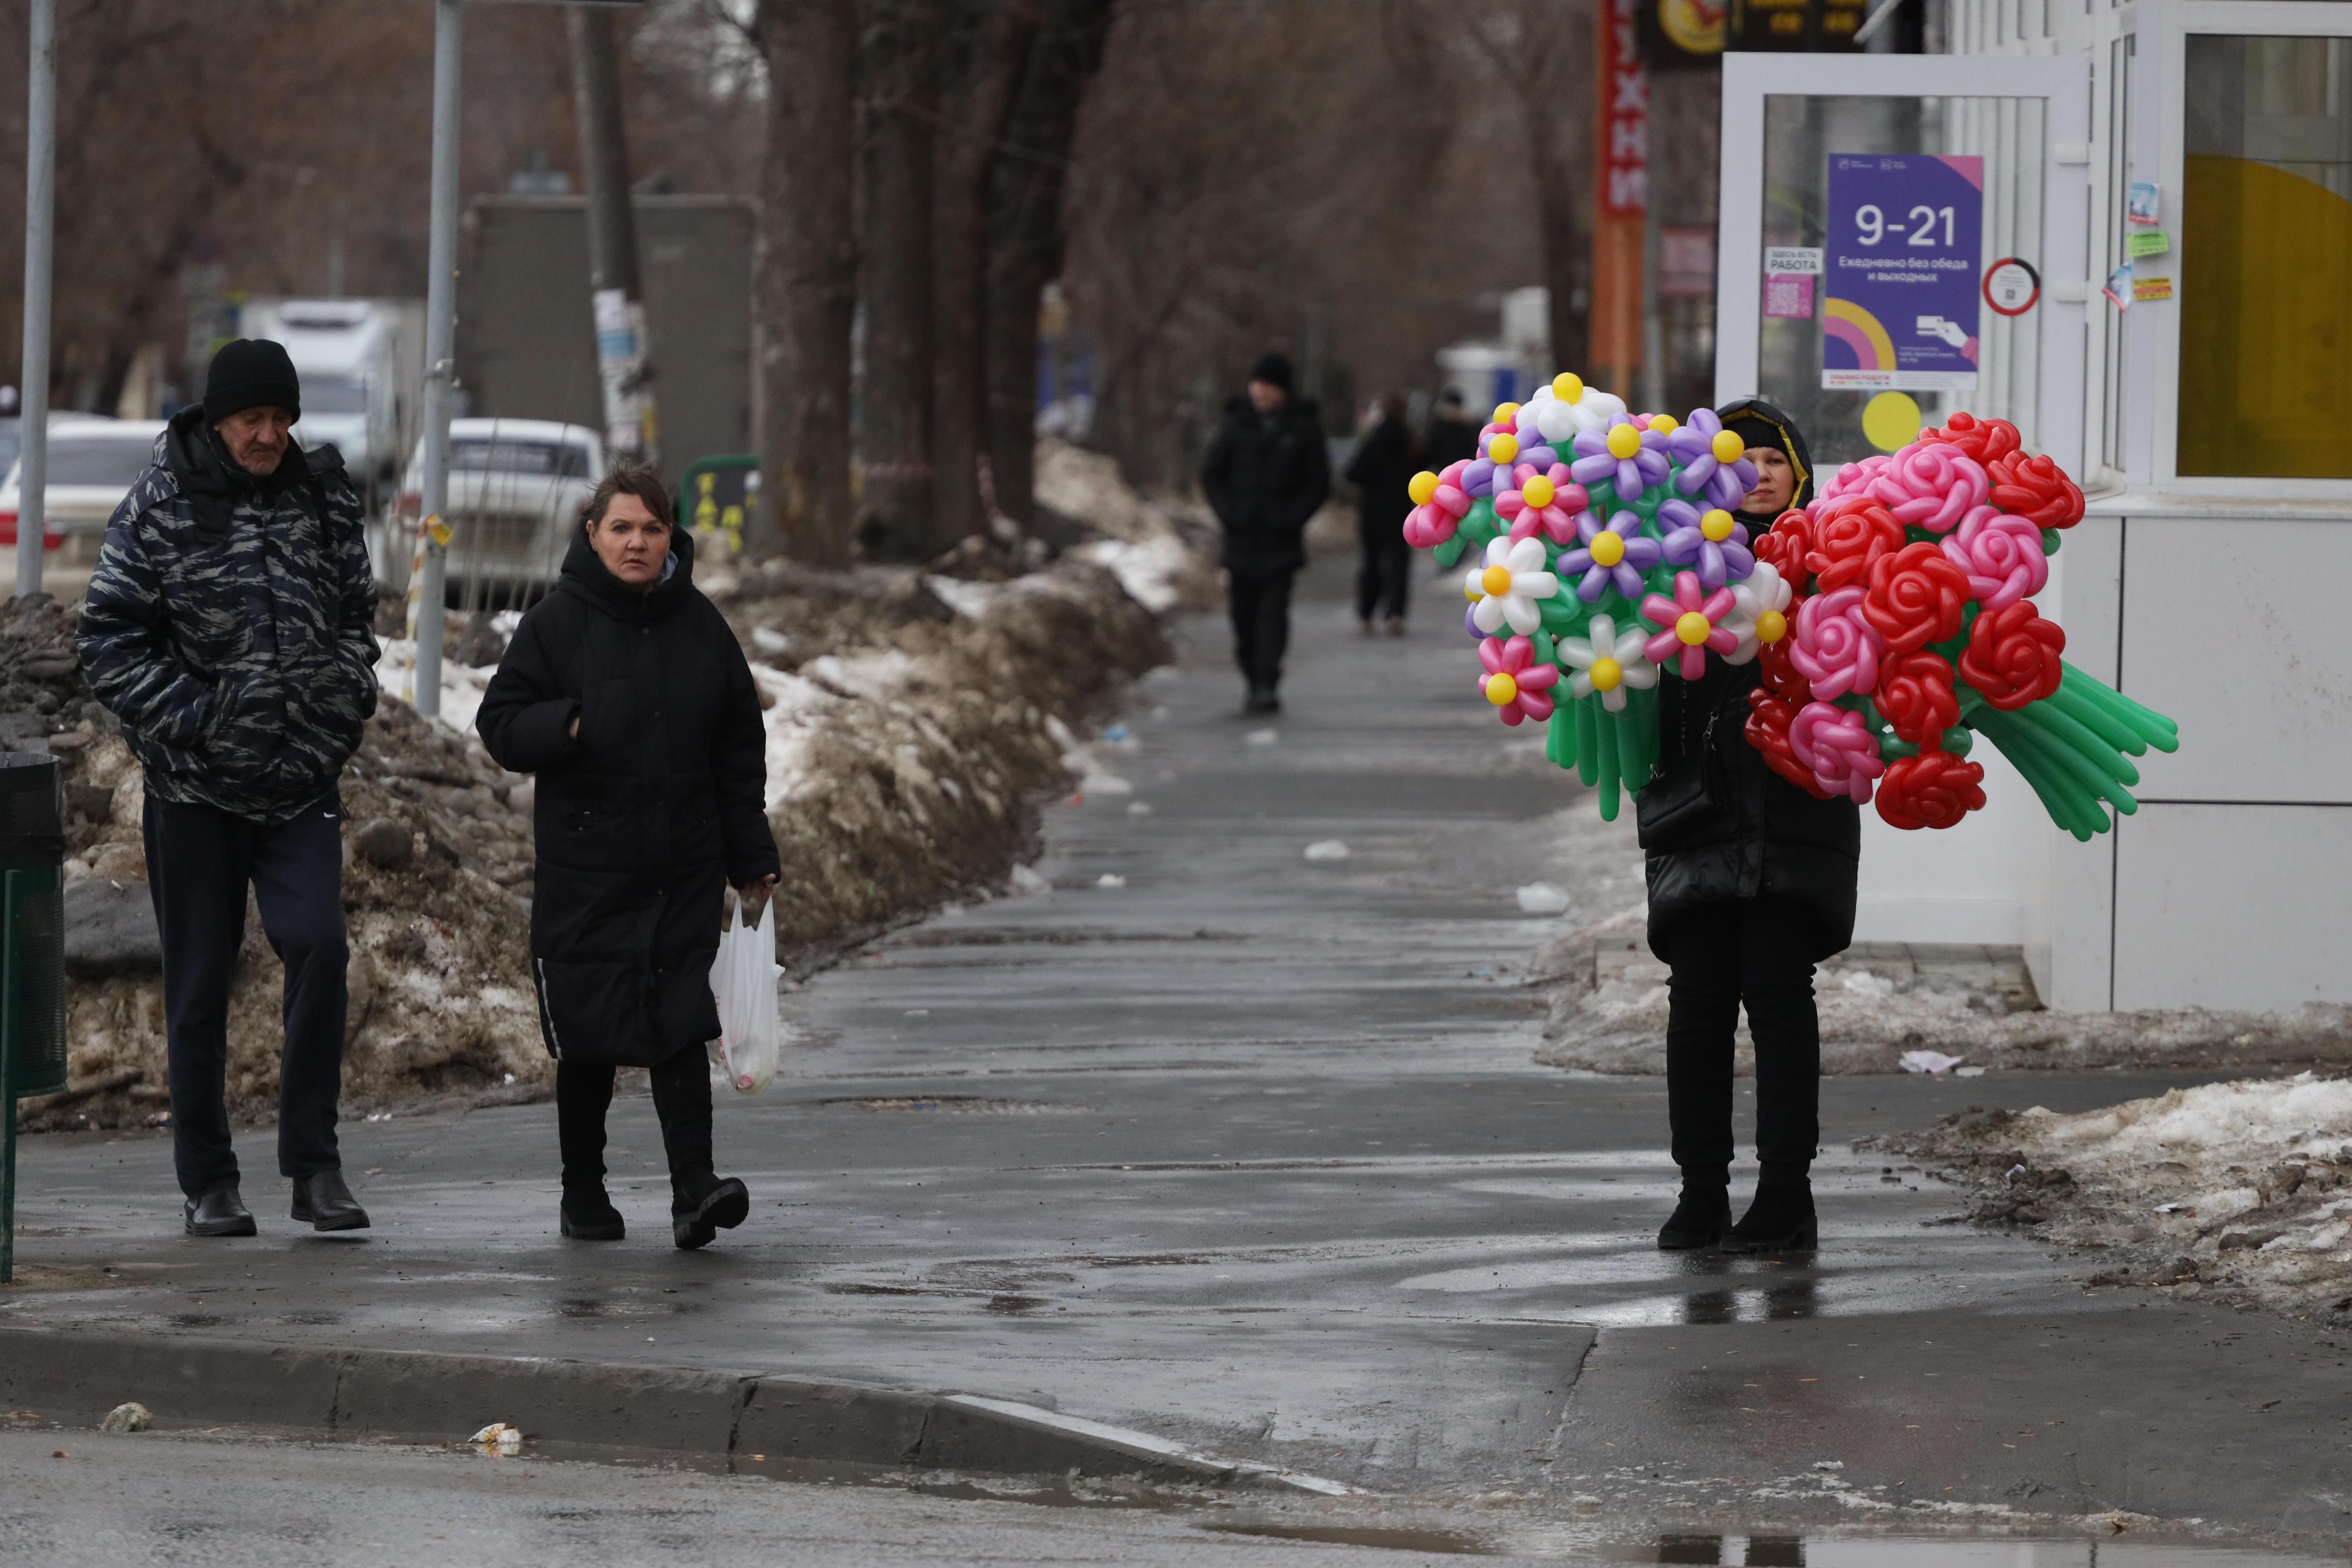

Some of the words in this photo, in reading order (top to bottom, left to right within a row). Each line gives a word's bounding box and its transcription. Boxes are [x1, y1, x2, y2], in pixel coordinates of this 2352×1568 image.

[1855, 204, 1955, 246] 9-21
[1771, 260, 1817, 270] РАБОТА
[1838, 256, 1906, 268] Ежедневно
[1907, 257, 1929, 268] без
[1930, 258, 1969, 270] обеда
[1867, 272, 1876, 281] и
[1877, 272, 1939, 282] выходных
